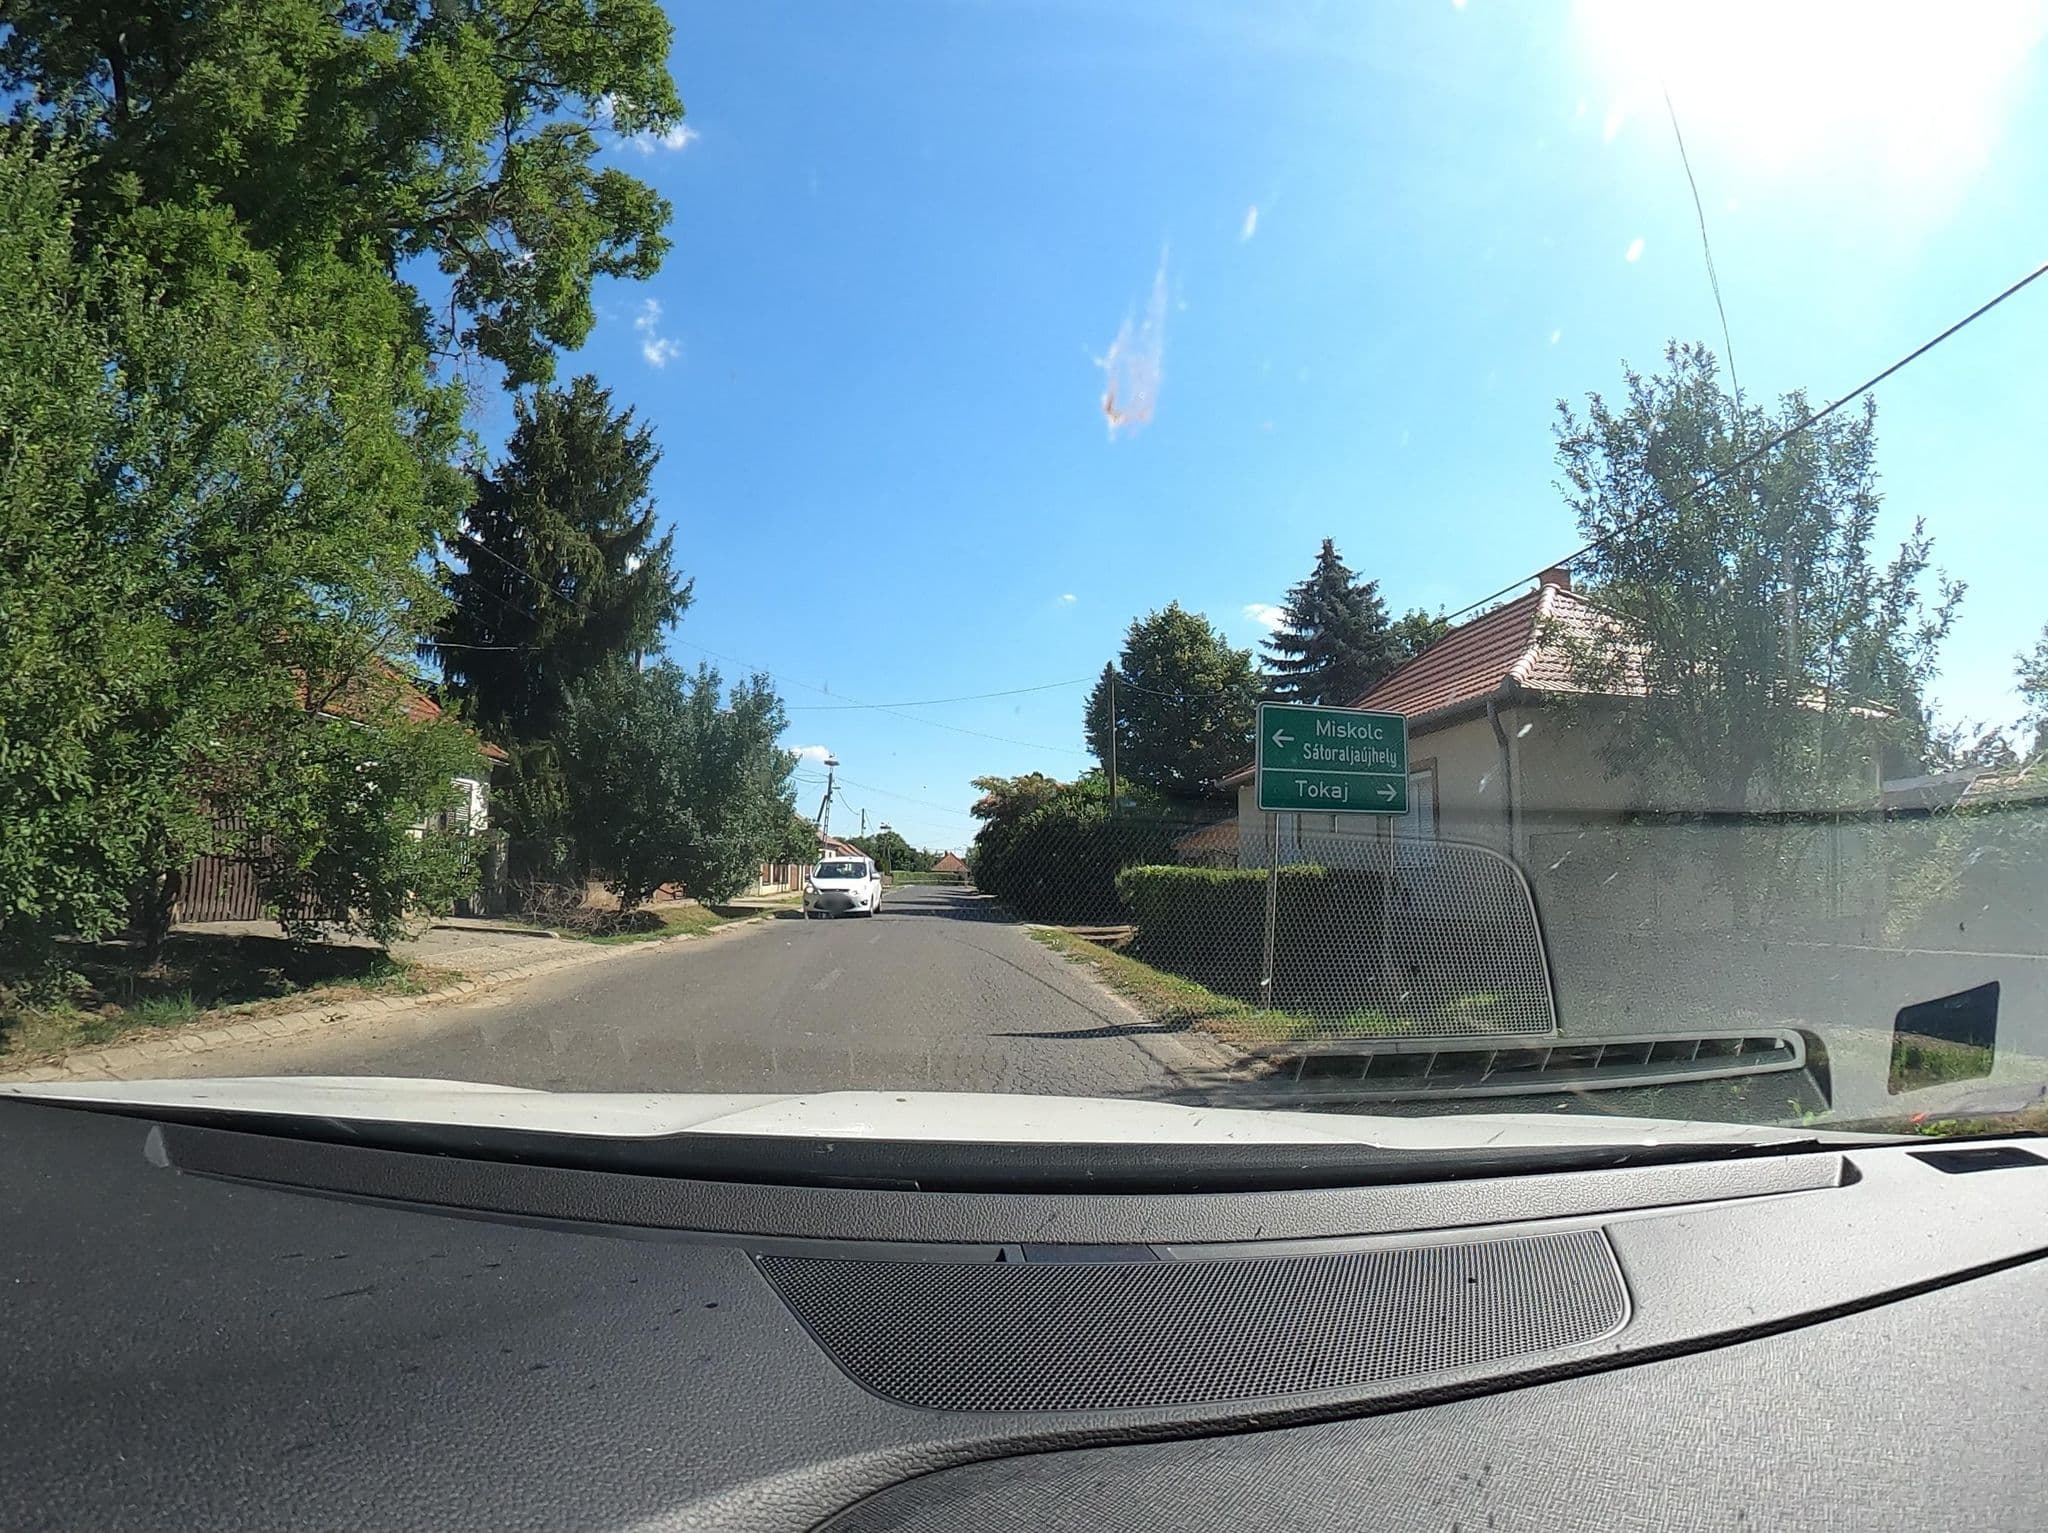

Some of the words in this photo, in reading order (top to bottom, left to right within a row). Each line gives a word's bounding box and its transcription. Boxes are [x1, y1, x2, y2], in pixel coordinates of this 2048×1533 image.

[1316, 719, 1384, 740] Miskolc
[1303, 743, 1397, 768] Sátoraljaújhely
[1295, 780, 1349, 802] Tokaj
